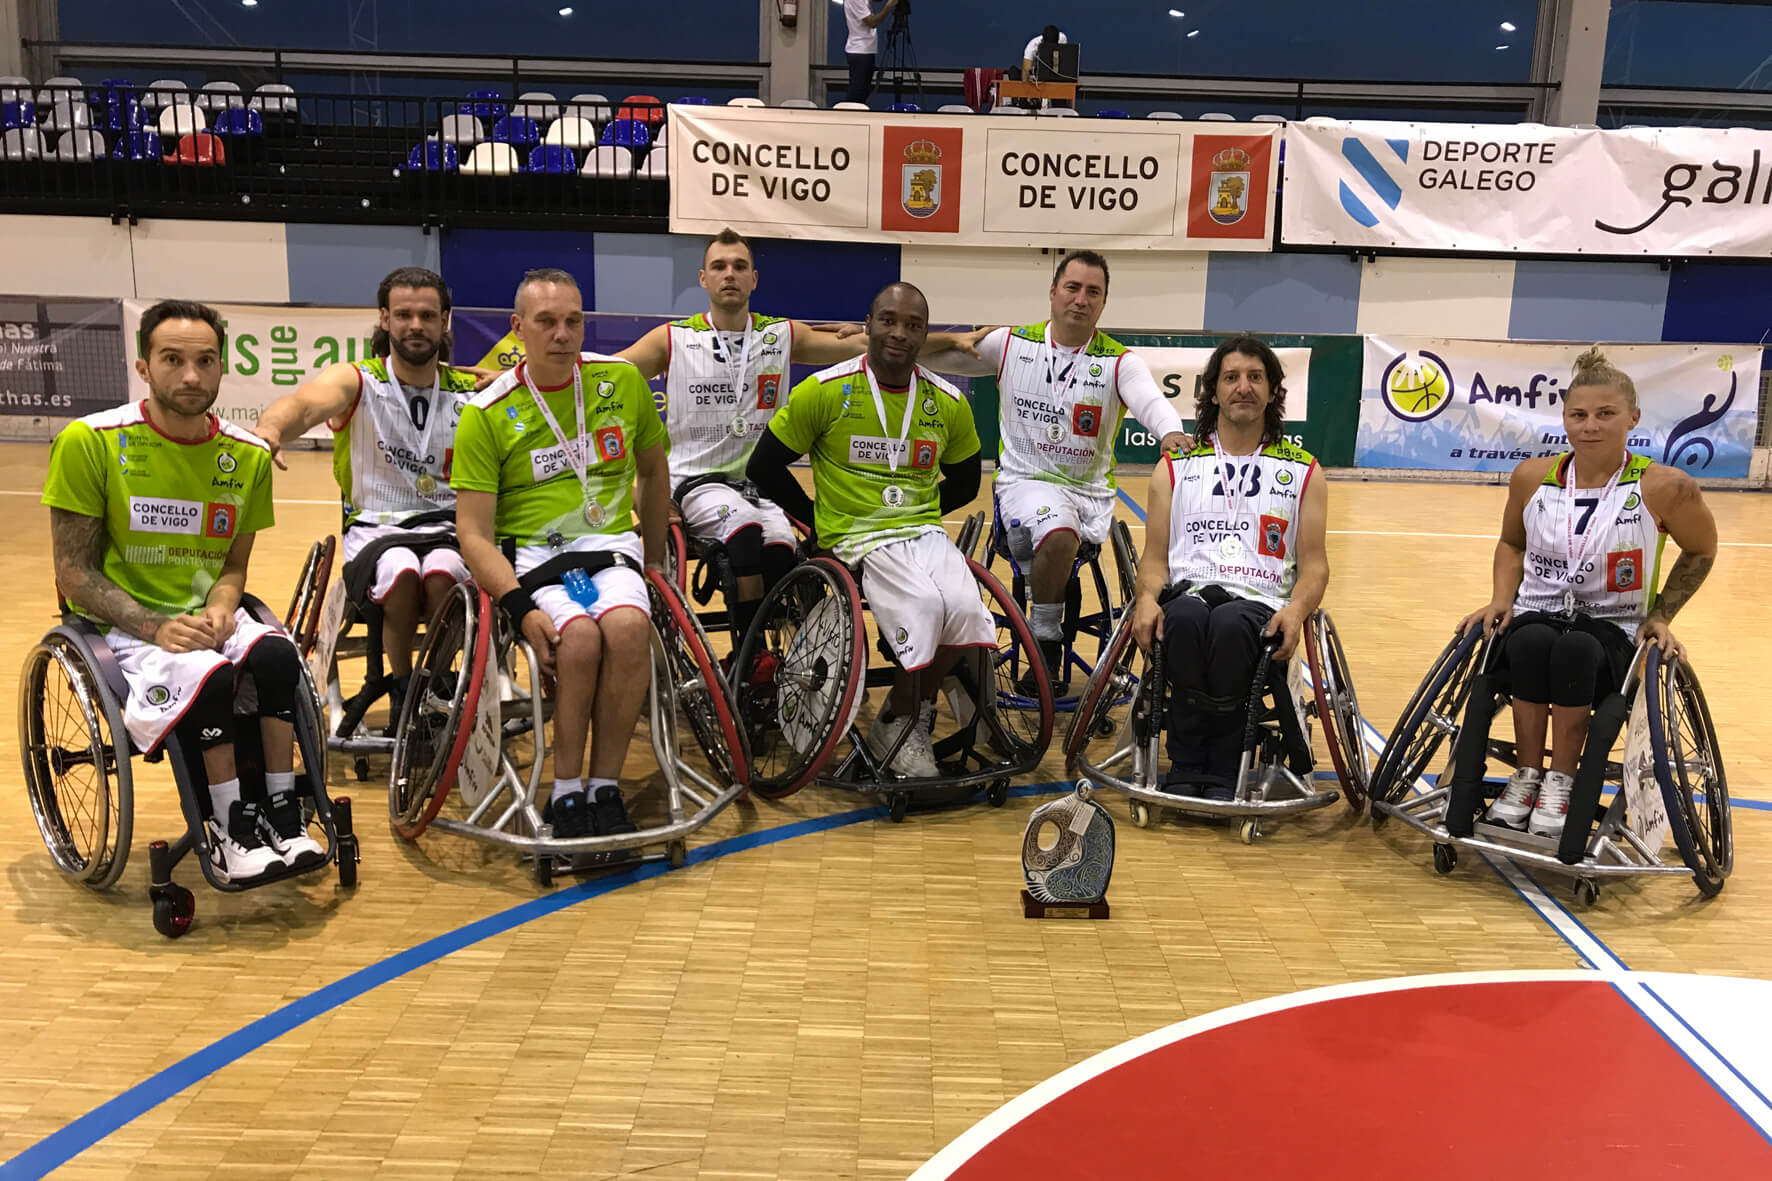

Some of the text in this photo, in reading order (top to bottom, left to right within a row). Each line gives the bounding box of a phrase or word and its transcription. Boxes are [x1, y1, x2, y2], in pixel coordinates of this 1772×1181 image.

[692, 139, 850, 171] CONCELLO
[1422, 140, 1556, 164] DEPORTE
[1001, 152, 1159, 180] CONCELLO
[1419, 168, 1536, 191] GALEGO
[711, 174, 831, 202] DE VIGO
[1018, 186, 1140, 212] DE VIGO
[11, 343, 58, 355] Nuestra
[270, 325, 306, 386] que
[17, 358, 63, 371] Fátima
[1045, 355, 1078, 389] 14
[688, 383, 749, 394] CONCELO
[696, 396, 710, 405] DE
[410, 395, 429, 431] 0
[1032, 410, 1058, 424] VIGO
[919, 419, 944, 428] Amfiv
[852, 440, 906, 452] CONCELO
[858, 451, 871, 460] DE
[1450, 447, 1463, 459] a
[1469, 447, 1531, 460] través
[543, 461, 559, 474] DE
[1212, 463, 1261, 497] 28
[1269, 486, 1297, 500] Amfiv
[133, 503, 198, 516] CONCELLO
[141, 515, 189, 527] DE VIGO
[1574, 498, 1599, 535] 7
[1186, 520, 1249, 533] CONCELLO
[1534, 566, 1550, 578] DE
